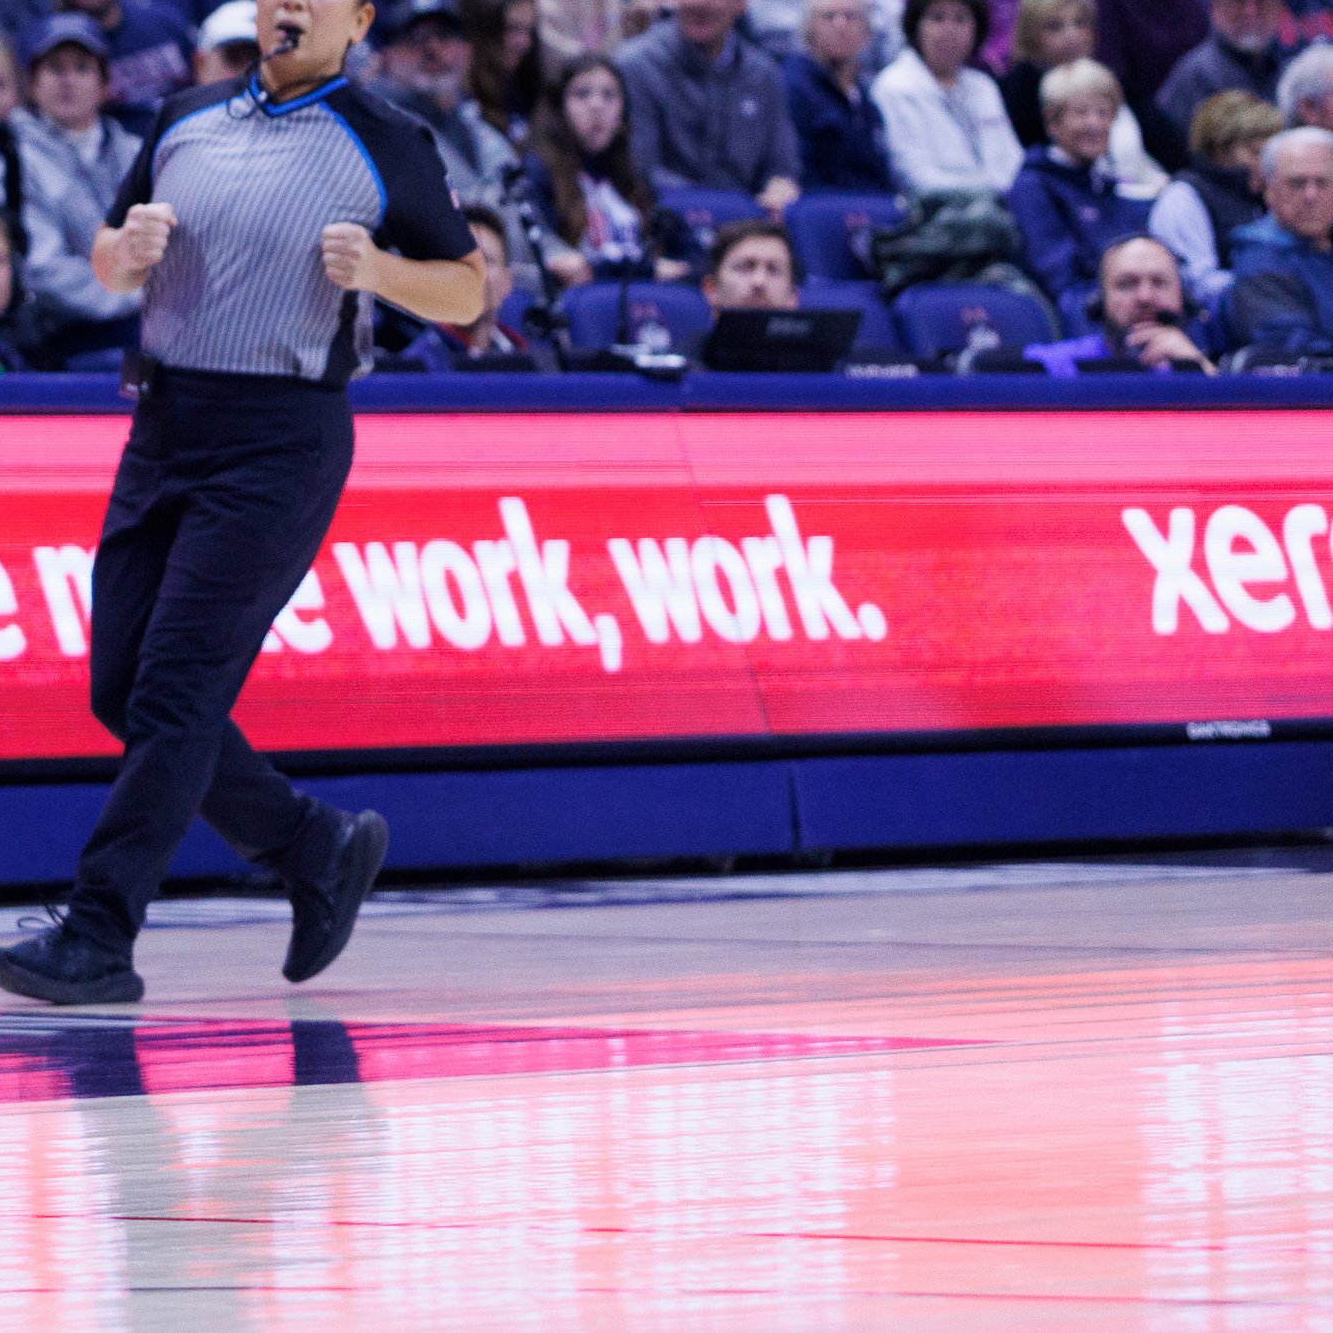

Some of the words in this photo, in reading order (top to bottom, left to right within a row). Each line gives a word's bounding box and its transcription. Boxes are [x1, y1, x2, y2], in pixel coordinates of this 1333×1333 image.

[333, 496, 623, 672] work,
[607, 493, 888, 643] work.
[1120, 502, 1333, 637] xer
